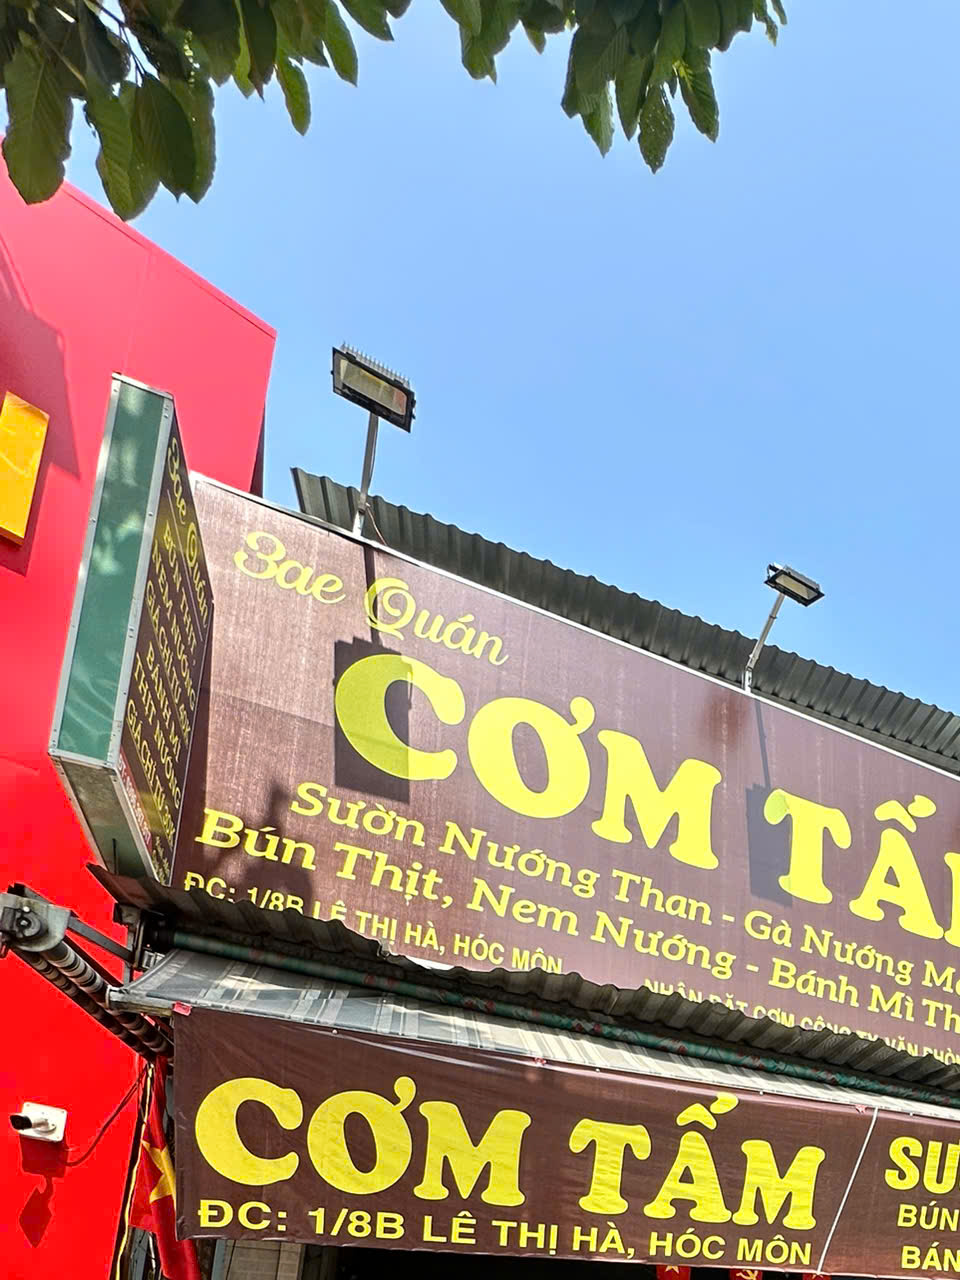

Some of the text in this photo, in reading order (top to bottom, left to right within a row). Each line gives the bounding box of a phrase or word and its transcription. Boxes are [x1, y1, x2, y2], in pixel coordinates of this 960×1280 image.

[233, 531, 509, 667] 3ae Quán
[334, 653, 723, 870] CƠM
[195, 808, 317, 870] Bún
[333, 841, 454, 909] Thịt,
[466, 877, 580, 937] Nem
[591, 909, 733, 979] Nướng
[768, 956, 860, 1009] Bánh
[870, 990, 915, 1024] Mì
[291, 781, 425, 847] Sườn
[440, 820, 600, 898] Nướng
[612, 868, 712, 925] Than
[744, 909, 792, 947] Gà
[801, 924, 914, 987] Nướng
[355, 910, 397, 945] THỊ
[404, 920, 445, 956] HÀ,
[453, 933, 505, 965] HÓC
[511, 947, 562, 974] MÔN
[195, 1075, 826, 1231] CƠM TẤM
[897, 1200, 960, 1232] BÚN
[197, 1199, 813, 1266] ĐC: 1/8B LÊ THỊ HÀ, HÓC MÔN
